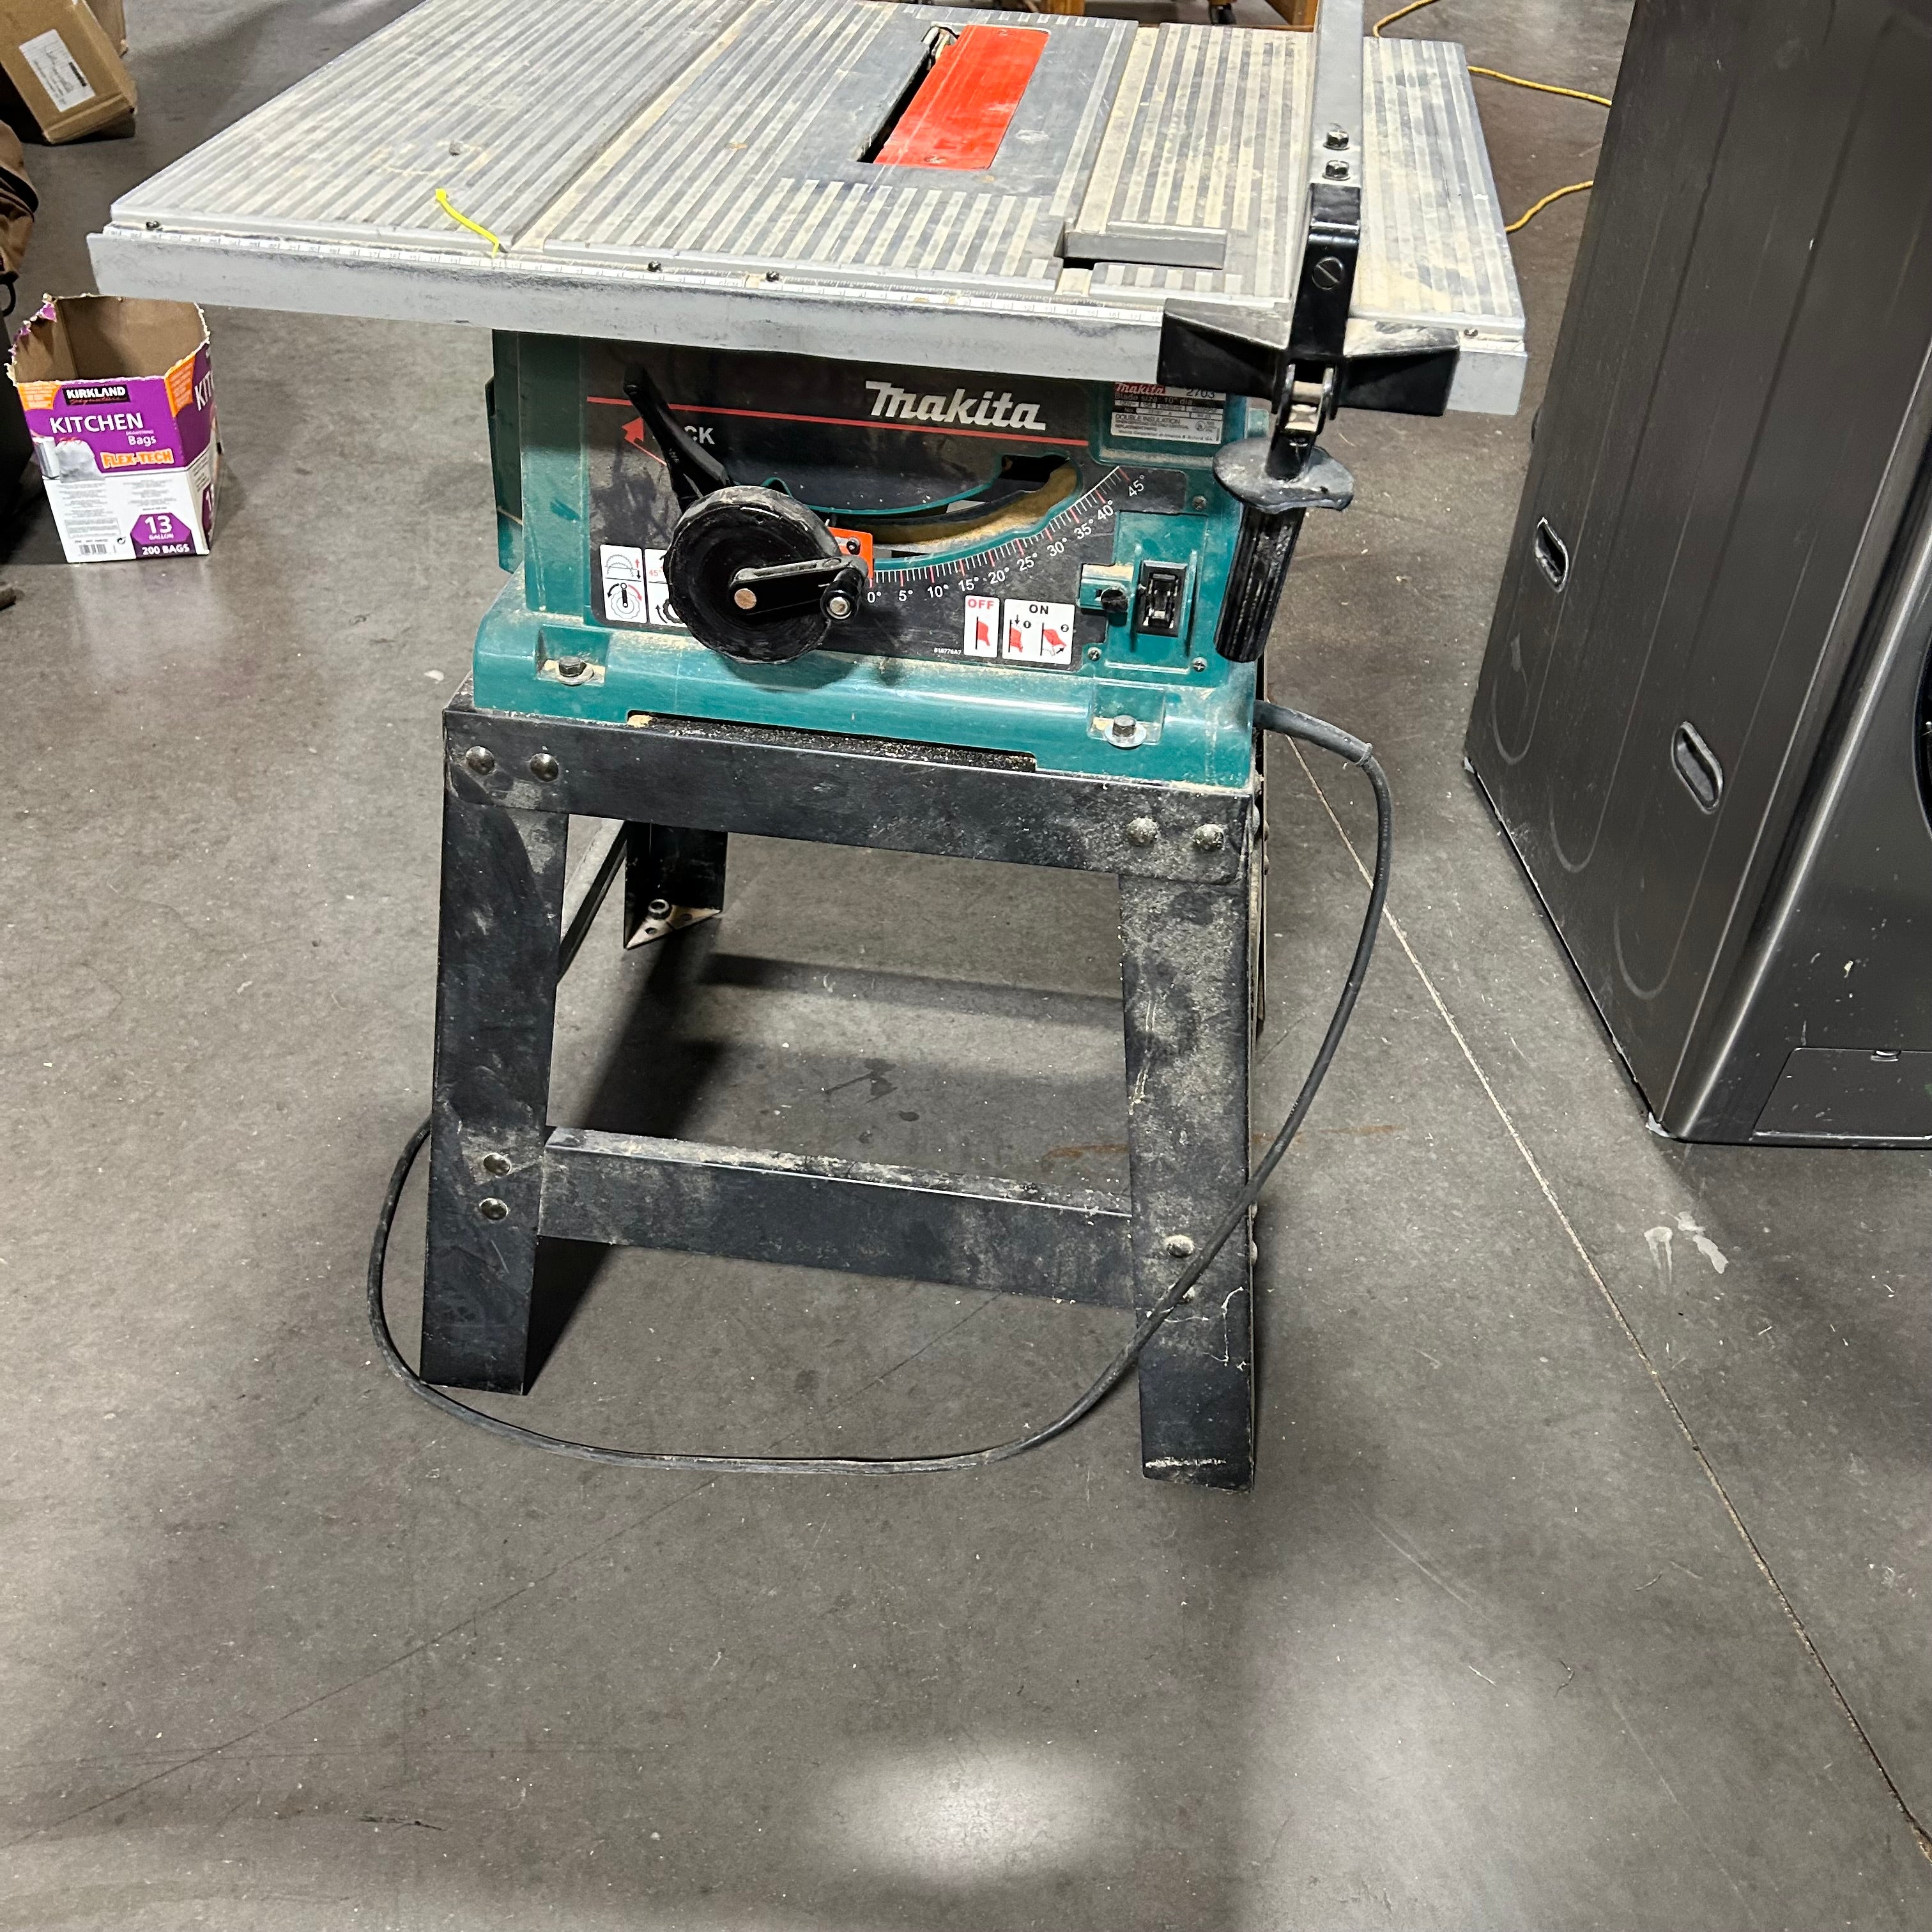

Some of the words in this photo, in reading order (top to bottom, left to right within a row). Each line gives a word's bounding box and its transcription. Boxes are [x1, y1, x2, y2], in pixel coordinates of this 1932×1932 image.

[66, 387, 126, 399] KIRKLAND
[1186, 388, 1215, 399] 2703
[49, 412, 144, 434] KITCHEN
[128, 435, 157, 447] Bags
[101, 448, 174, 468] FLEX-TECH
[144, 515, 172, 534] 13
[142, 546, 160, 555] 200
[162, 544, 190, 554] BAGS
[967, 599, 995, 610] OFF
[1029, 604, 1049, 615] ON
